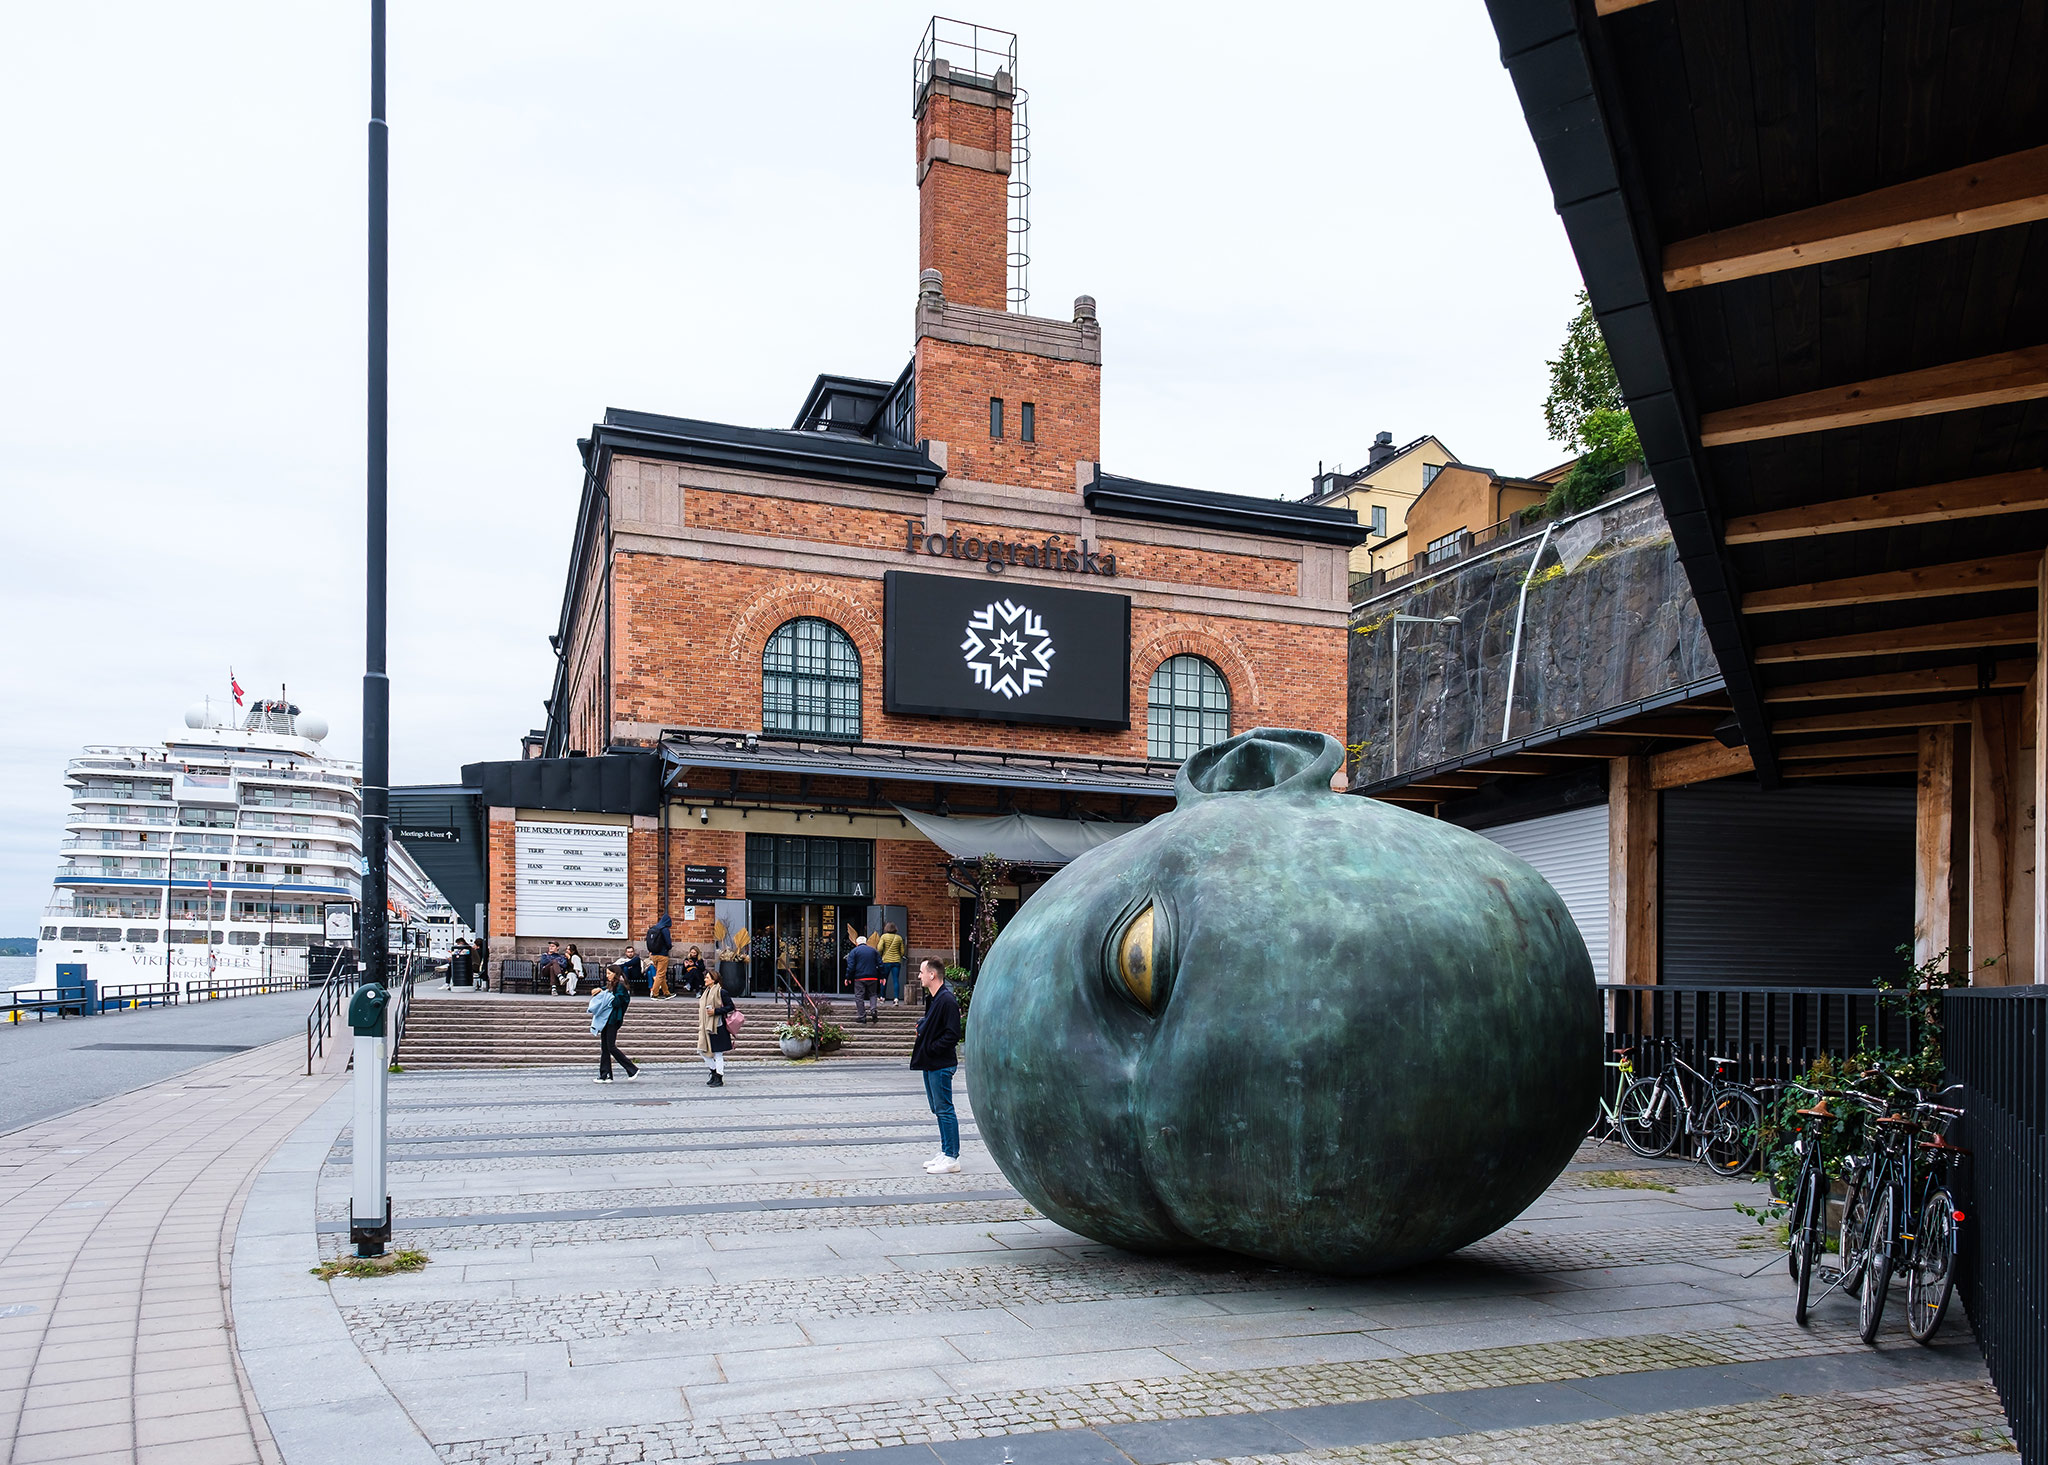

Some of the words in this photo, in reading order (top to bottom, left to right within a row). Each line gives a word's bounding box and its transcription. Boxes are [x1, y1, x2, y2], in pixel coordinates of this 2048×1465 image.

[905, 519, 1117, 576] Fotografiska
[400, 830, 424, 839] Meetings
[573, 829, 625, 837] PHOTOGRAPHY
[853, 883, 864, 896] A
[132, 955, 188, 966] VIKING
[193, 957, 251, 968] JUITER
